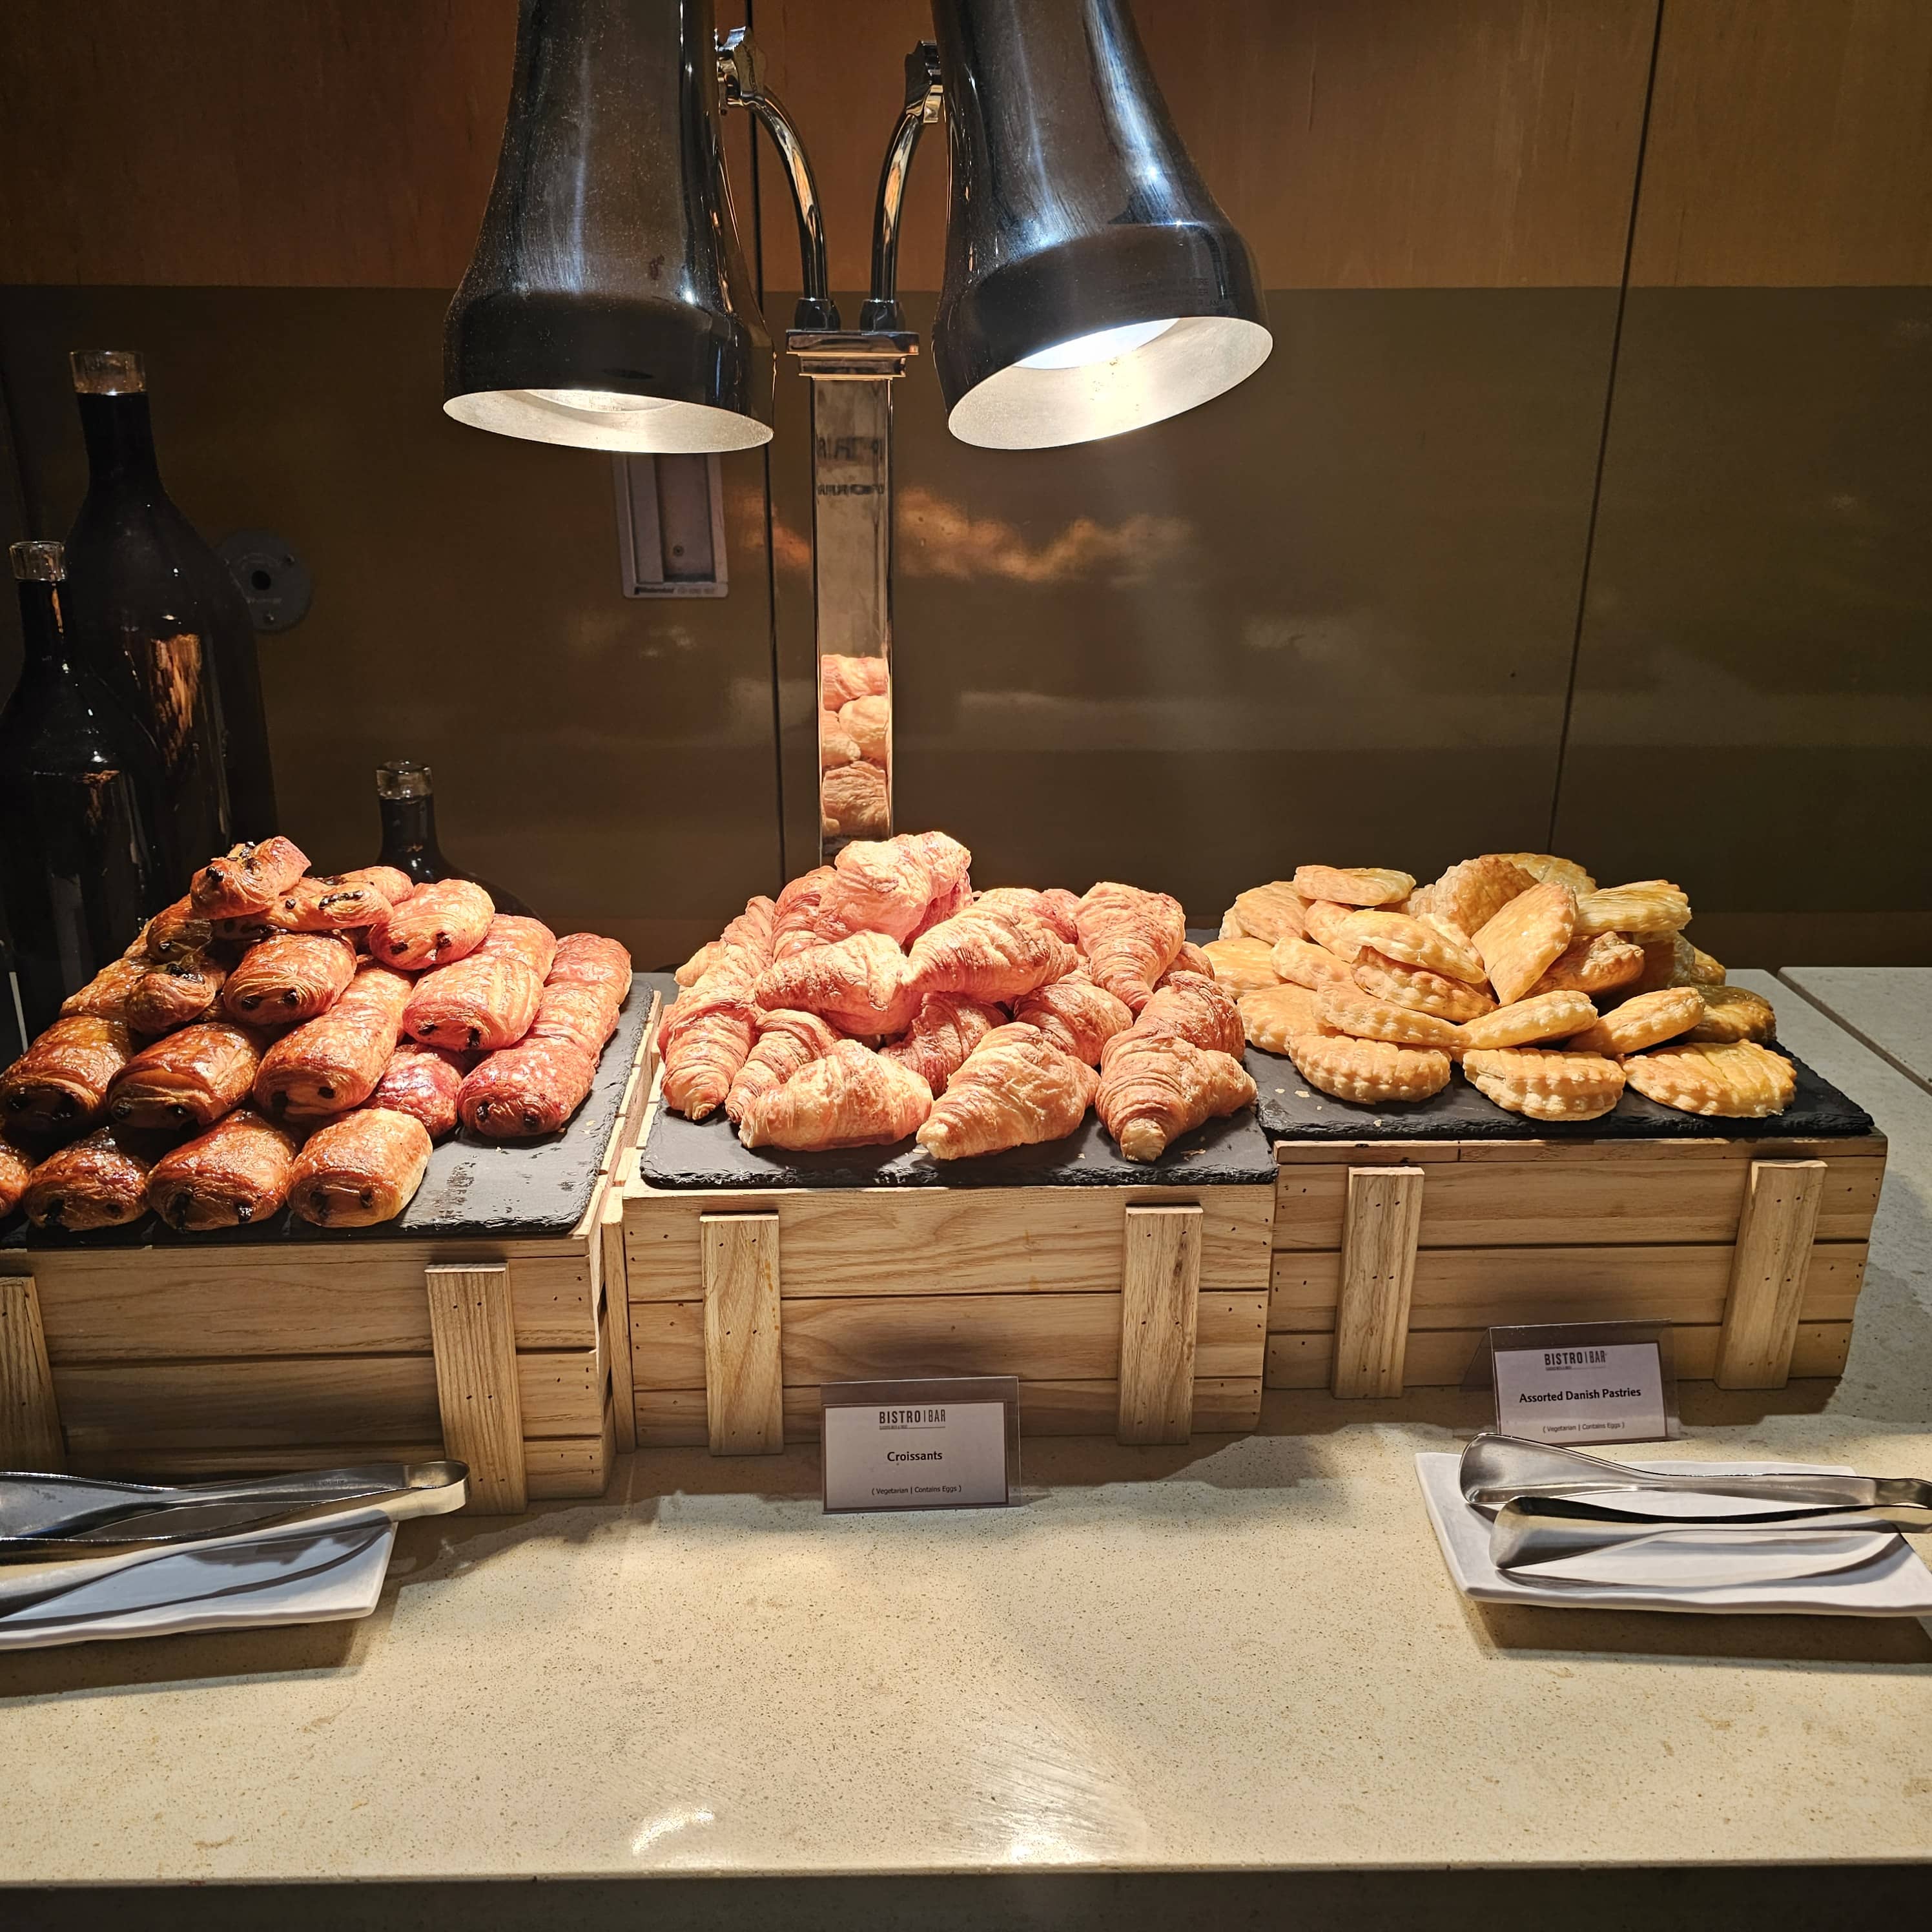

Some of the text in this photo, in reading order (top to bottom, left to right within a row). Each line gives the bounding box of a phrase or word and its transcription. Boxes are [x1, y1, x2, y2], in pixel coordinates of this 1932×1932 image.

[1519, 1387, 1641, 1403] Assorted Danish Pastries
[887, 1451, 943, 1462] Croissants
[876, 1487, 909, 1495] Vegetarian
[941, 1485, 958, 1494] Eggs
